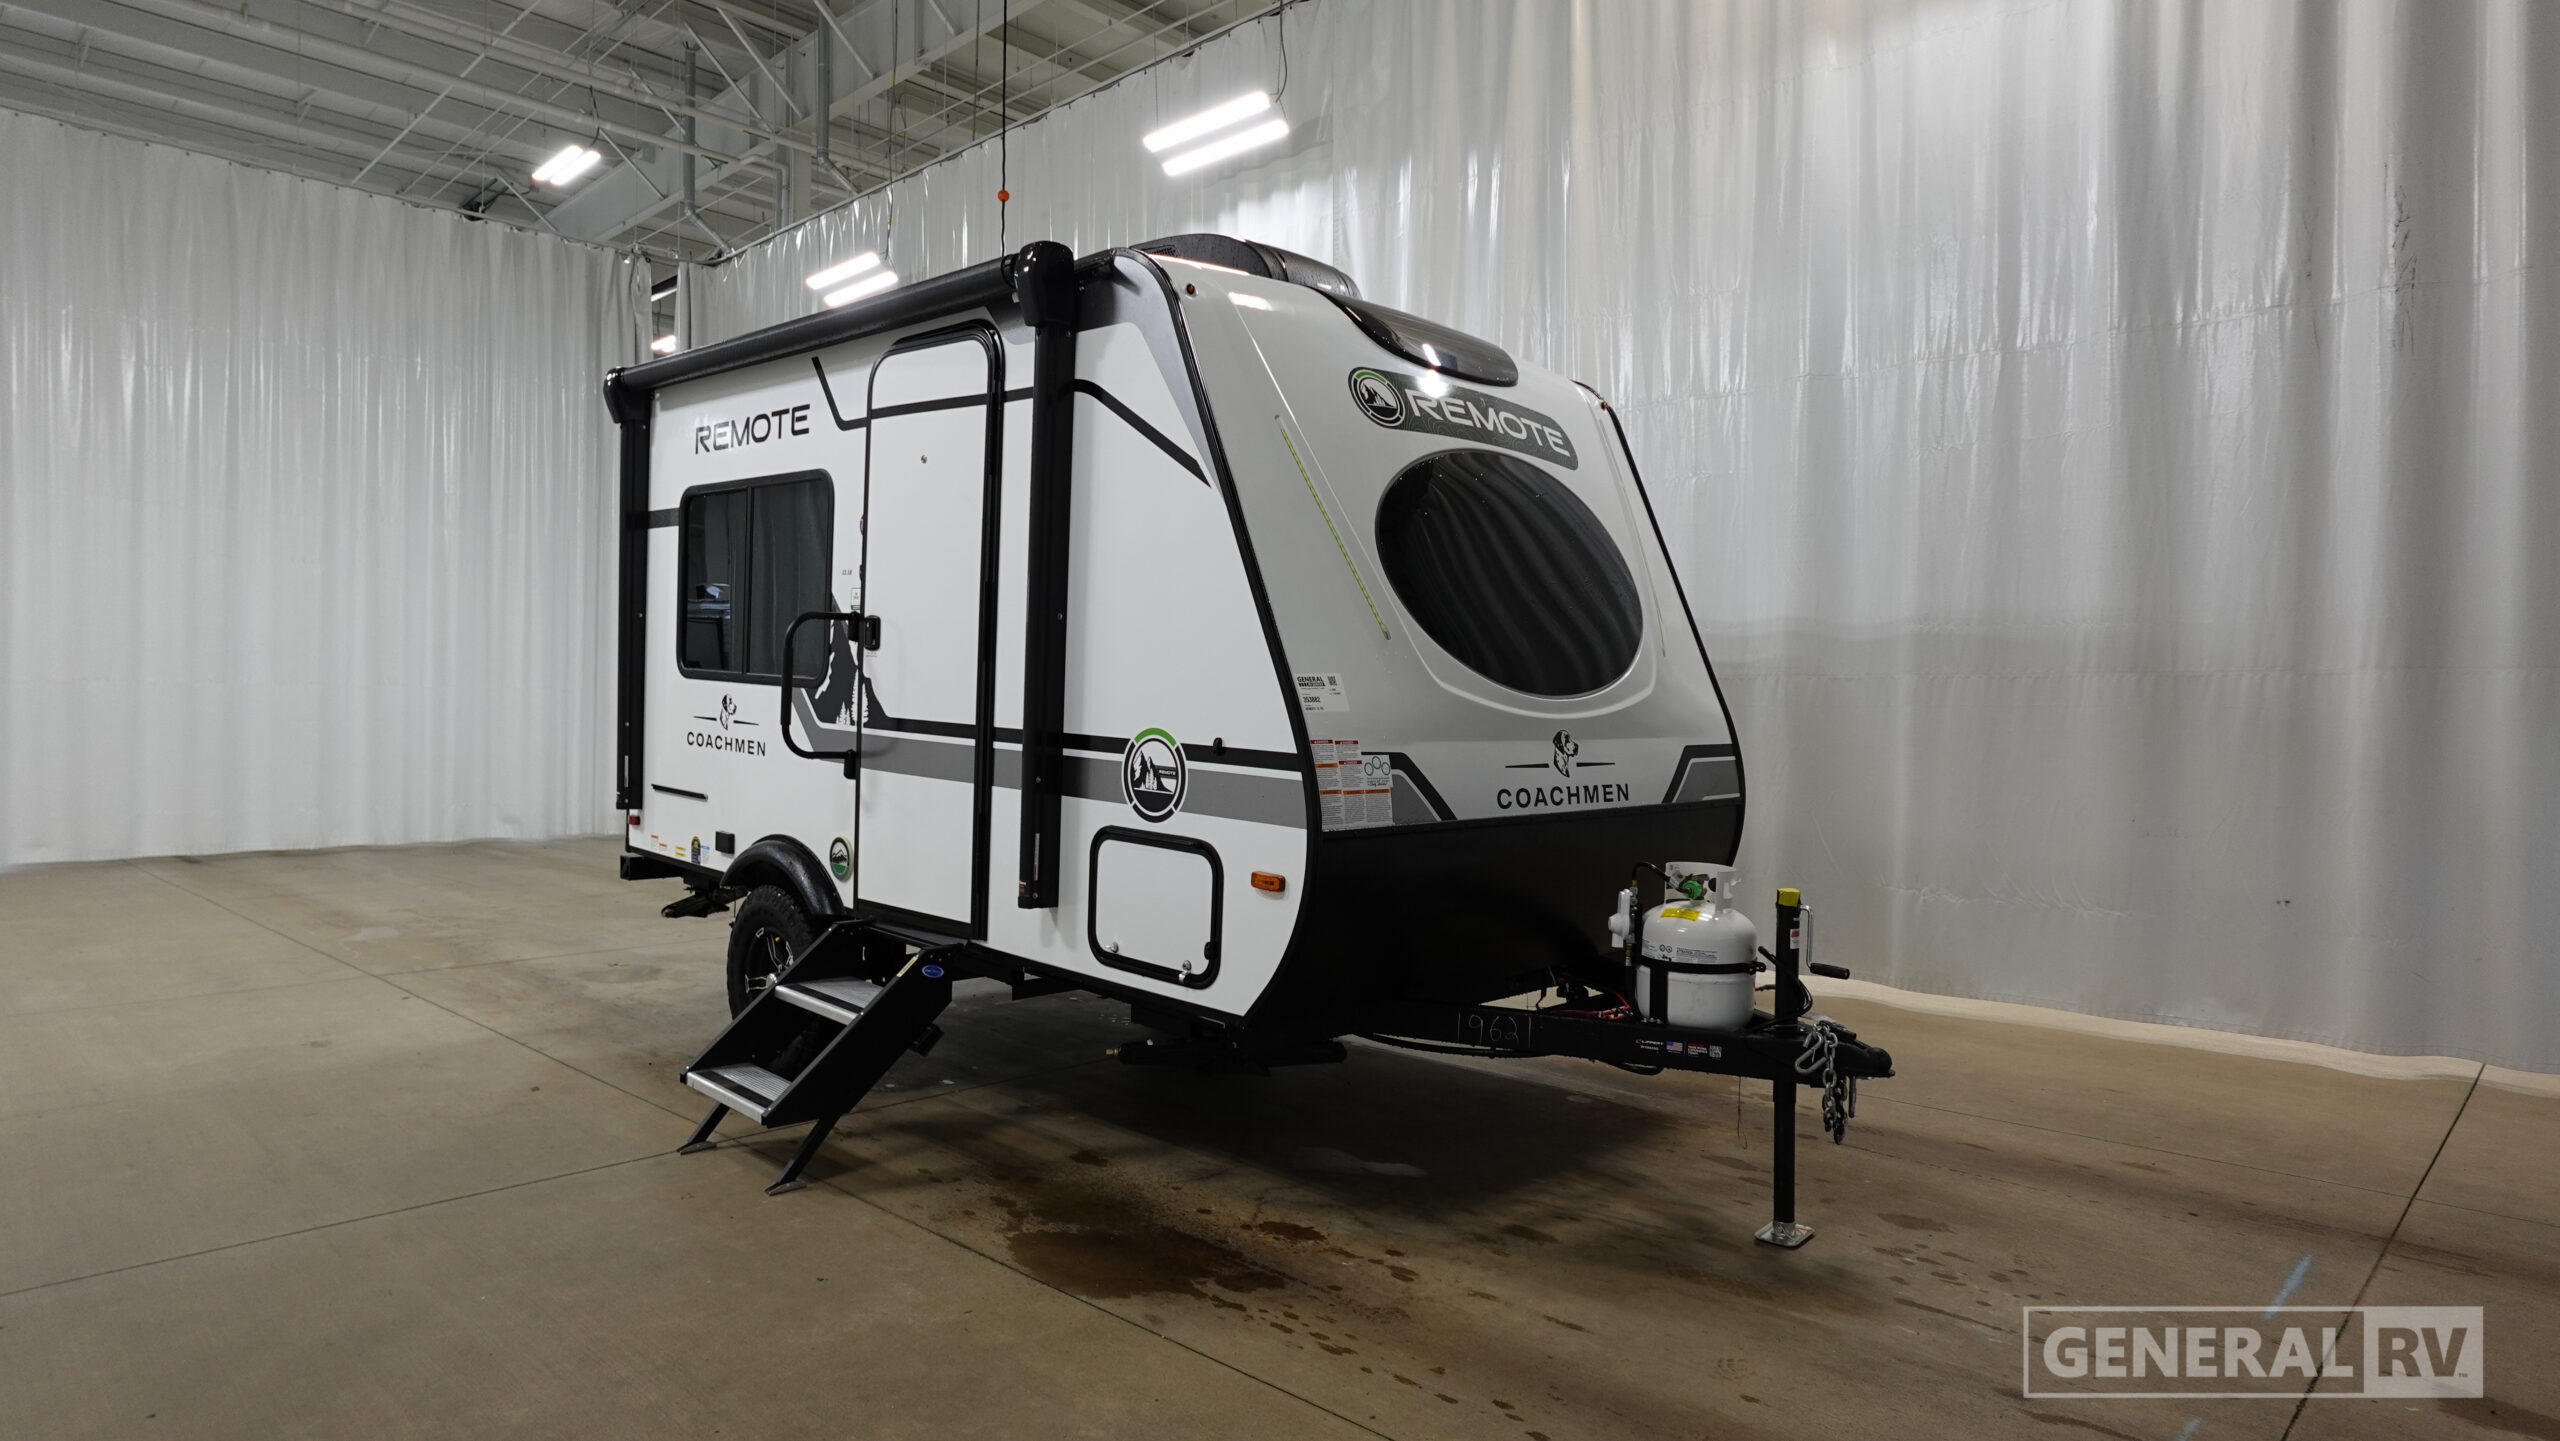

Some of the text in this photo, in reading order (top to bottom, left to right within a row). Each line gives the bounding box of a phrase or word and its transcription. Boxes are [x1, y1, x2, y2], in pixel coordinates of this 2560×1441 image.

[695, 403, 811, 455] REMOTE
[1404, 388, 1571, 457] REMOTE
[687, 731, 767, 757] COACHMEN
[1497, 783, 1630, 809] COACHMEN
